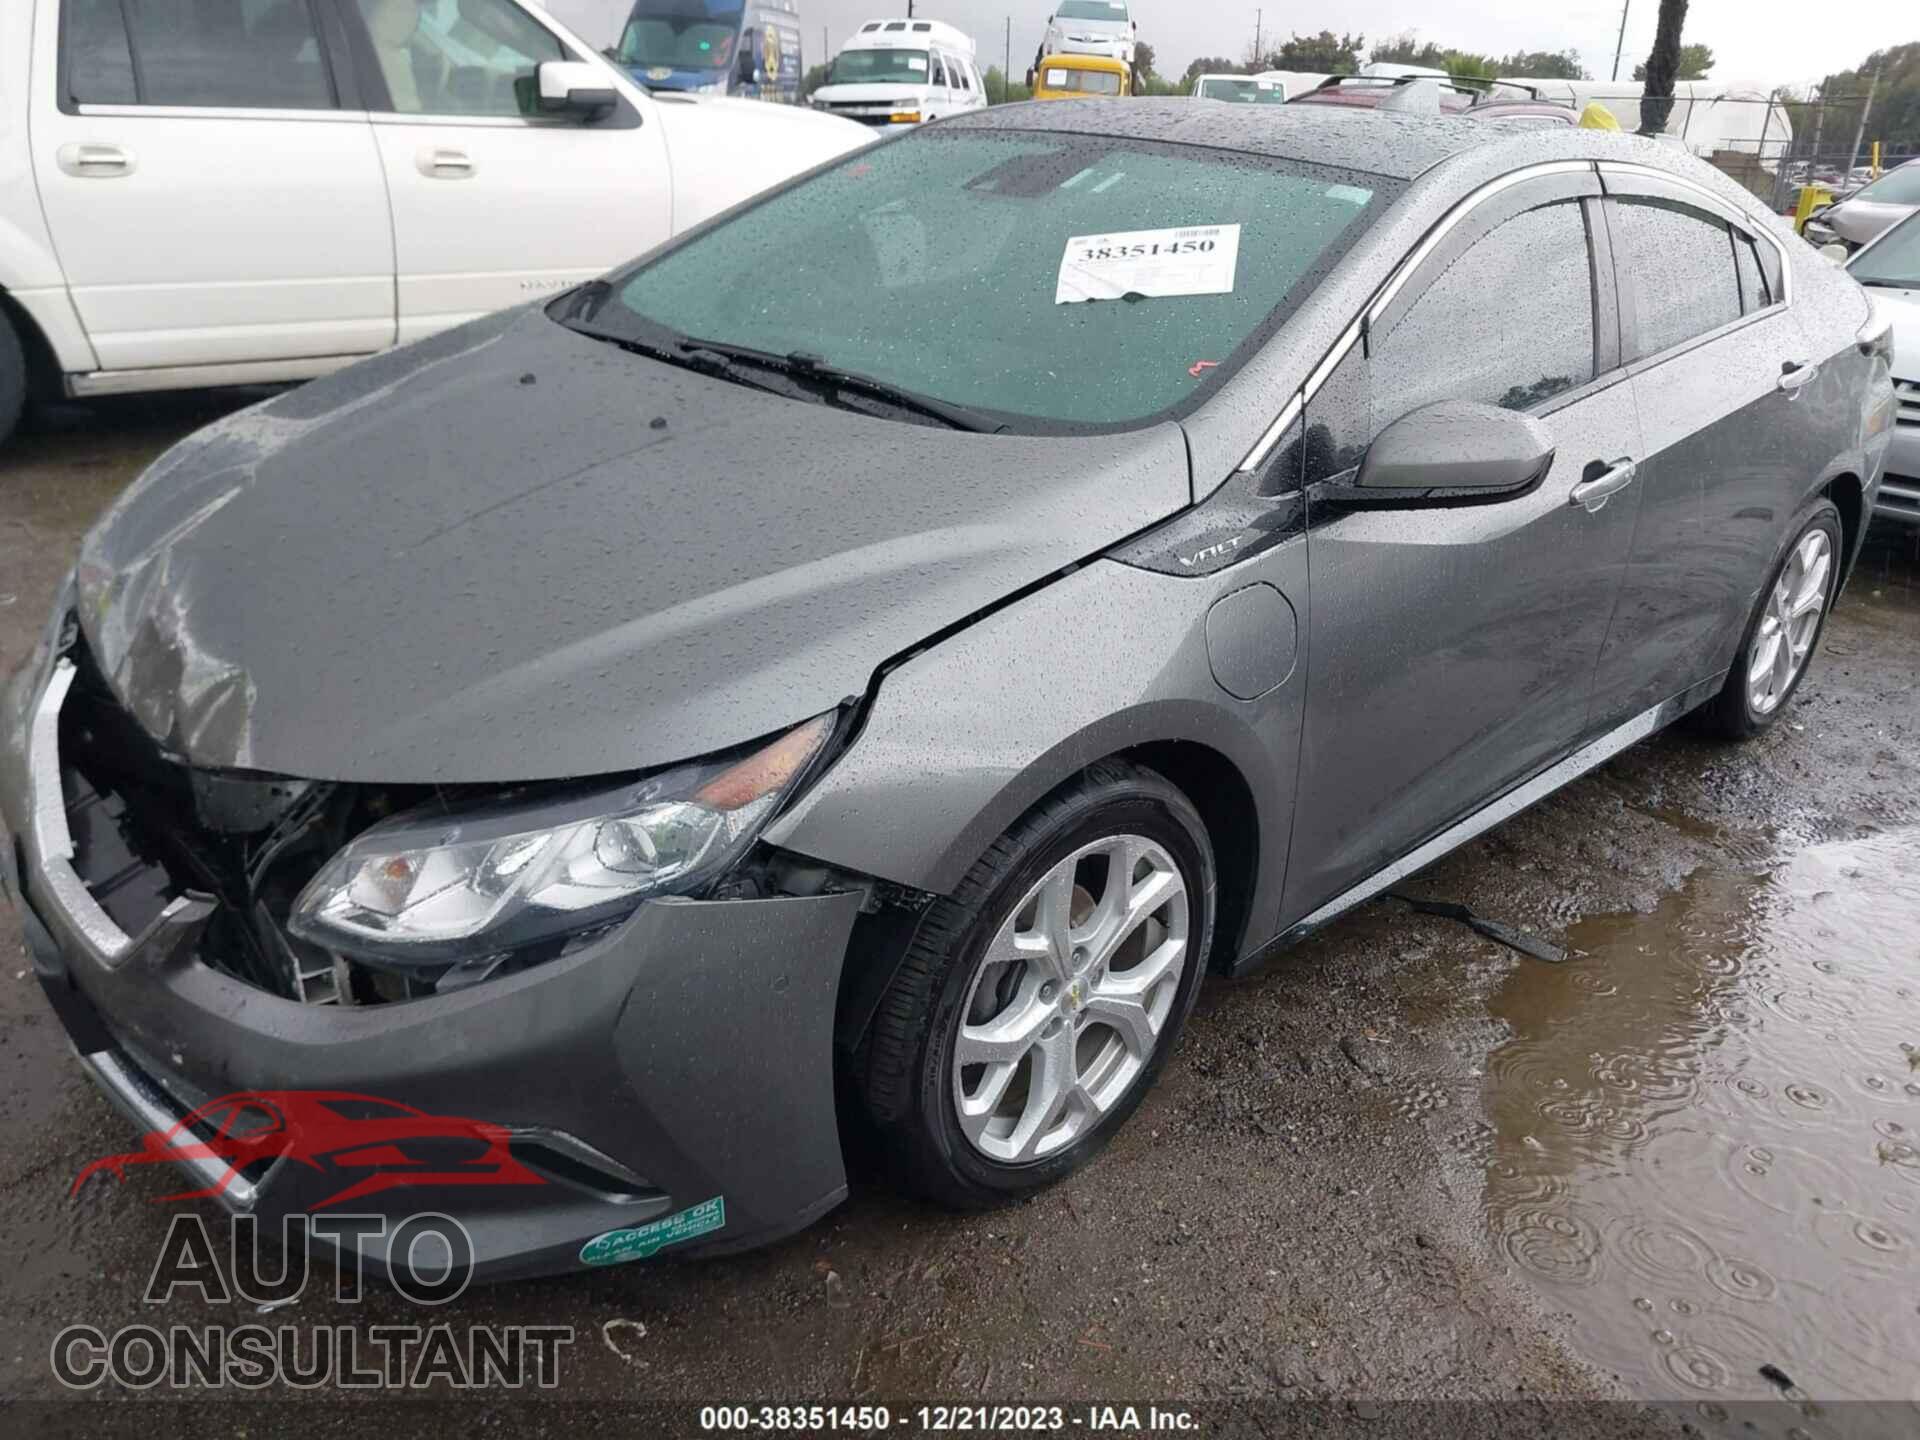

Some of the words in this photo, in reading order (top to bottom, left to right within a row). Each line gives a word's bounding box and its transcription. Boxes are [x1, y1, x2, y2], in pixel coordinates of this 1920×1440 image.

[1078, 240, 1215, 262] 38351450
[611, 1214, 686, 1247] ACCESS
[692, 1200, 718, 1217] OK
